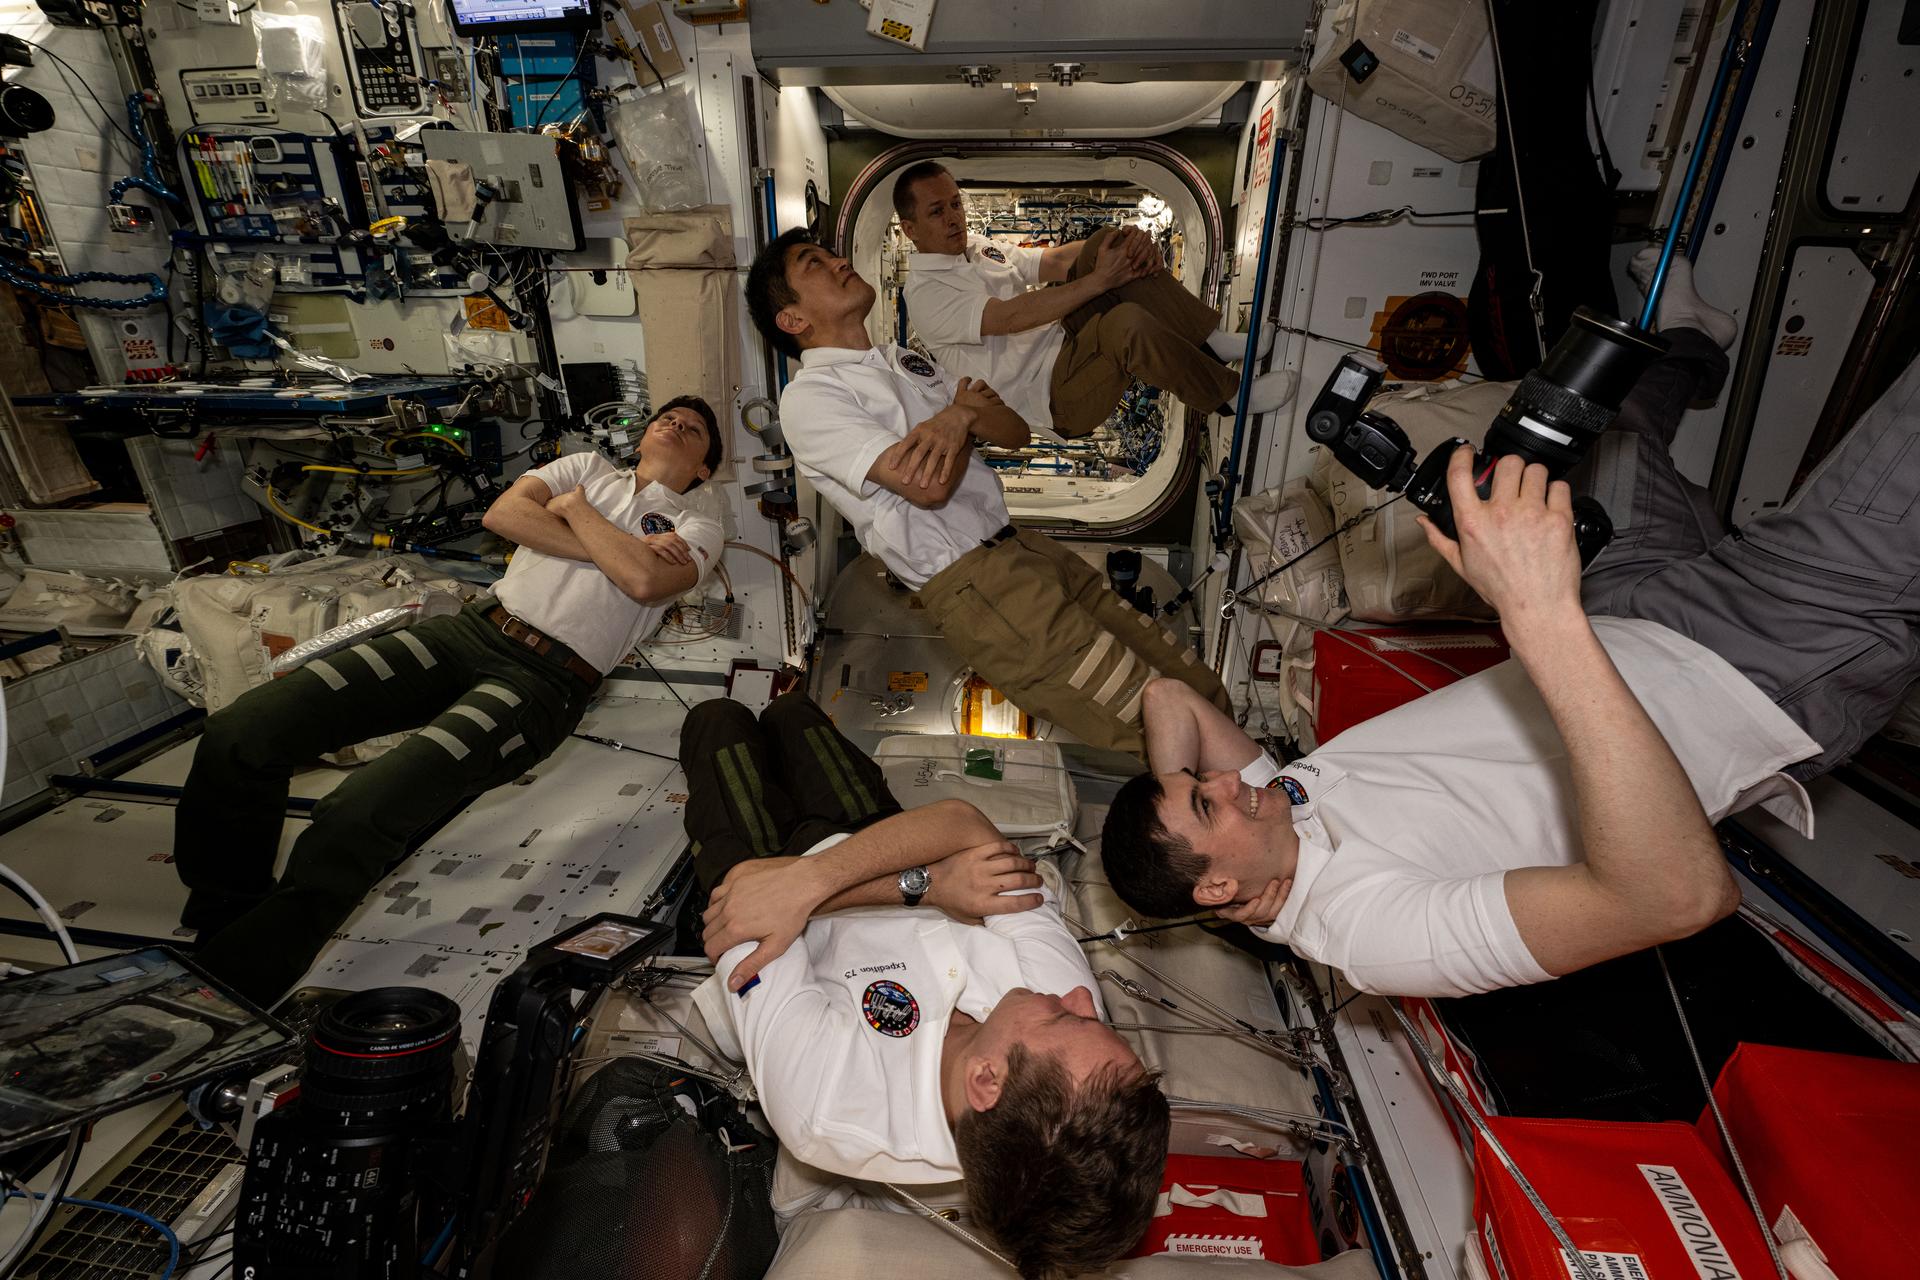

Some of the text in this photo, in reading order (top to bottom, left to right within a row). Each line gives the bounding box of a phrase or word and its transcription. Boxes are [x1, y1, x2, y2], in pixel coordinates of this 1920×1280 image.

[1434, 280, 1457, 288] VALVE
[844, 960, 907, 979] Expedition 73
[398, 1041, 415, 1049] VIDEO
[366, 1171, 377, 1185] 4K
[1647, 1169, 1736, 1280] AMMONIA
[1176, 1243, 1253, 1255] EMERGENCY USE
